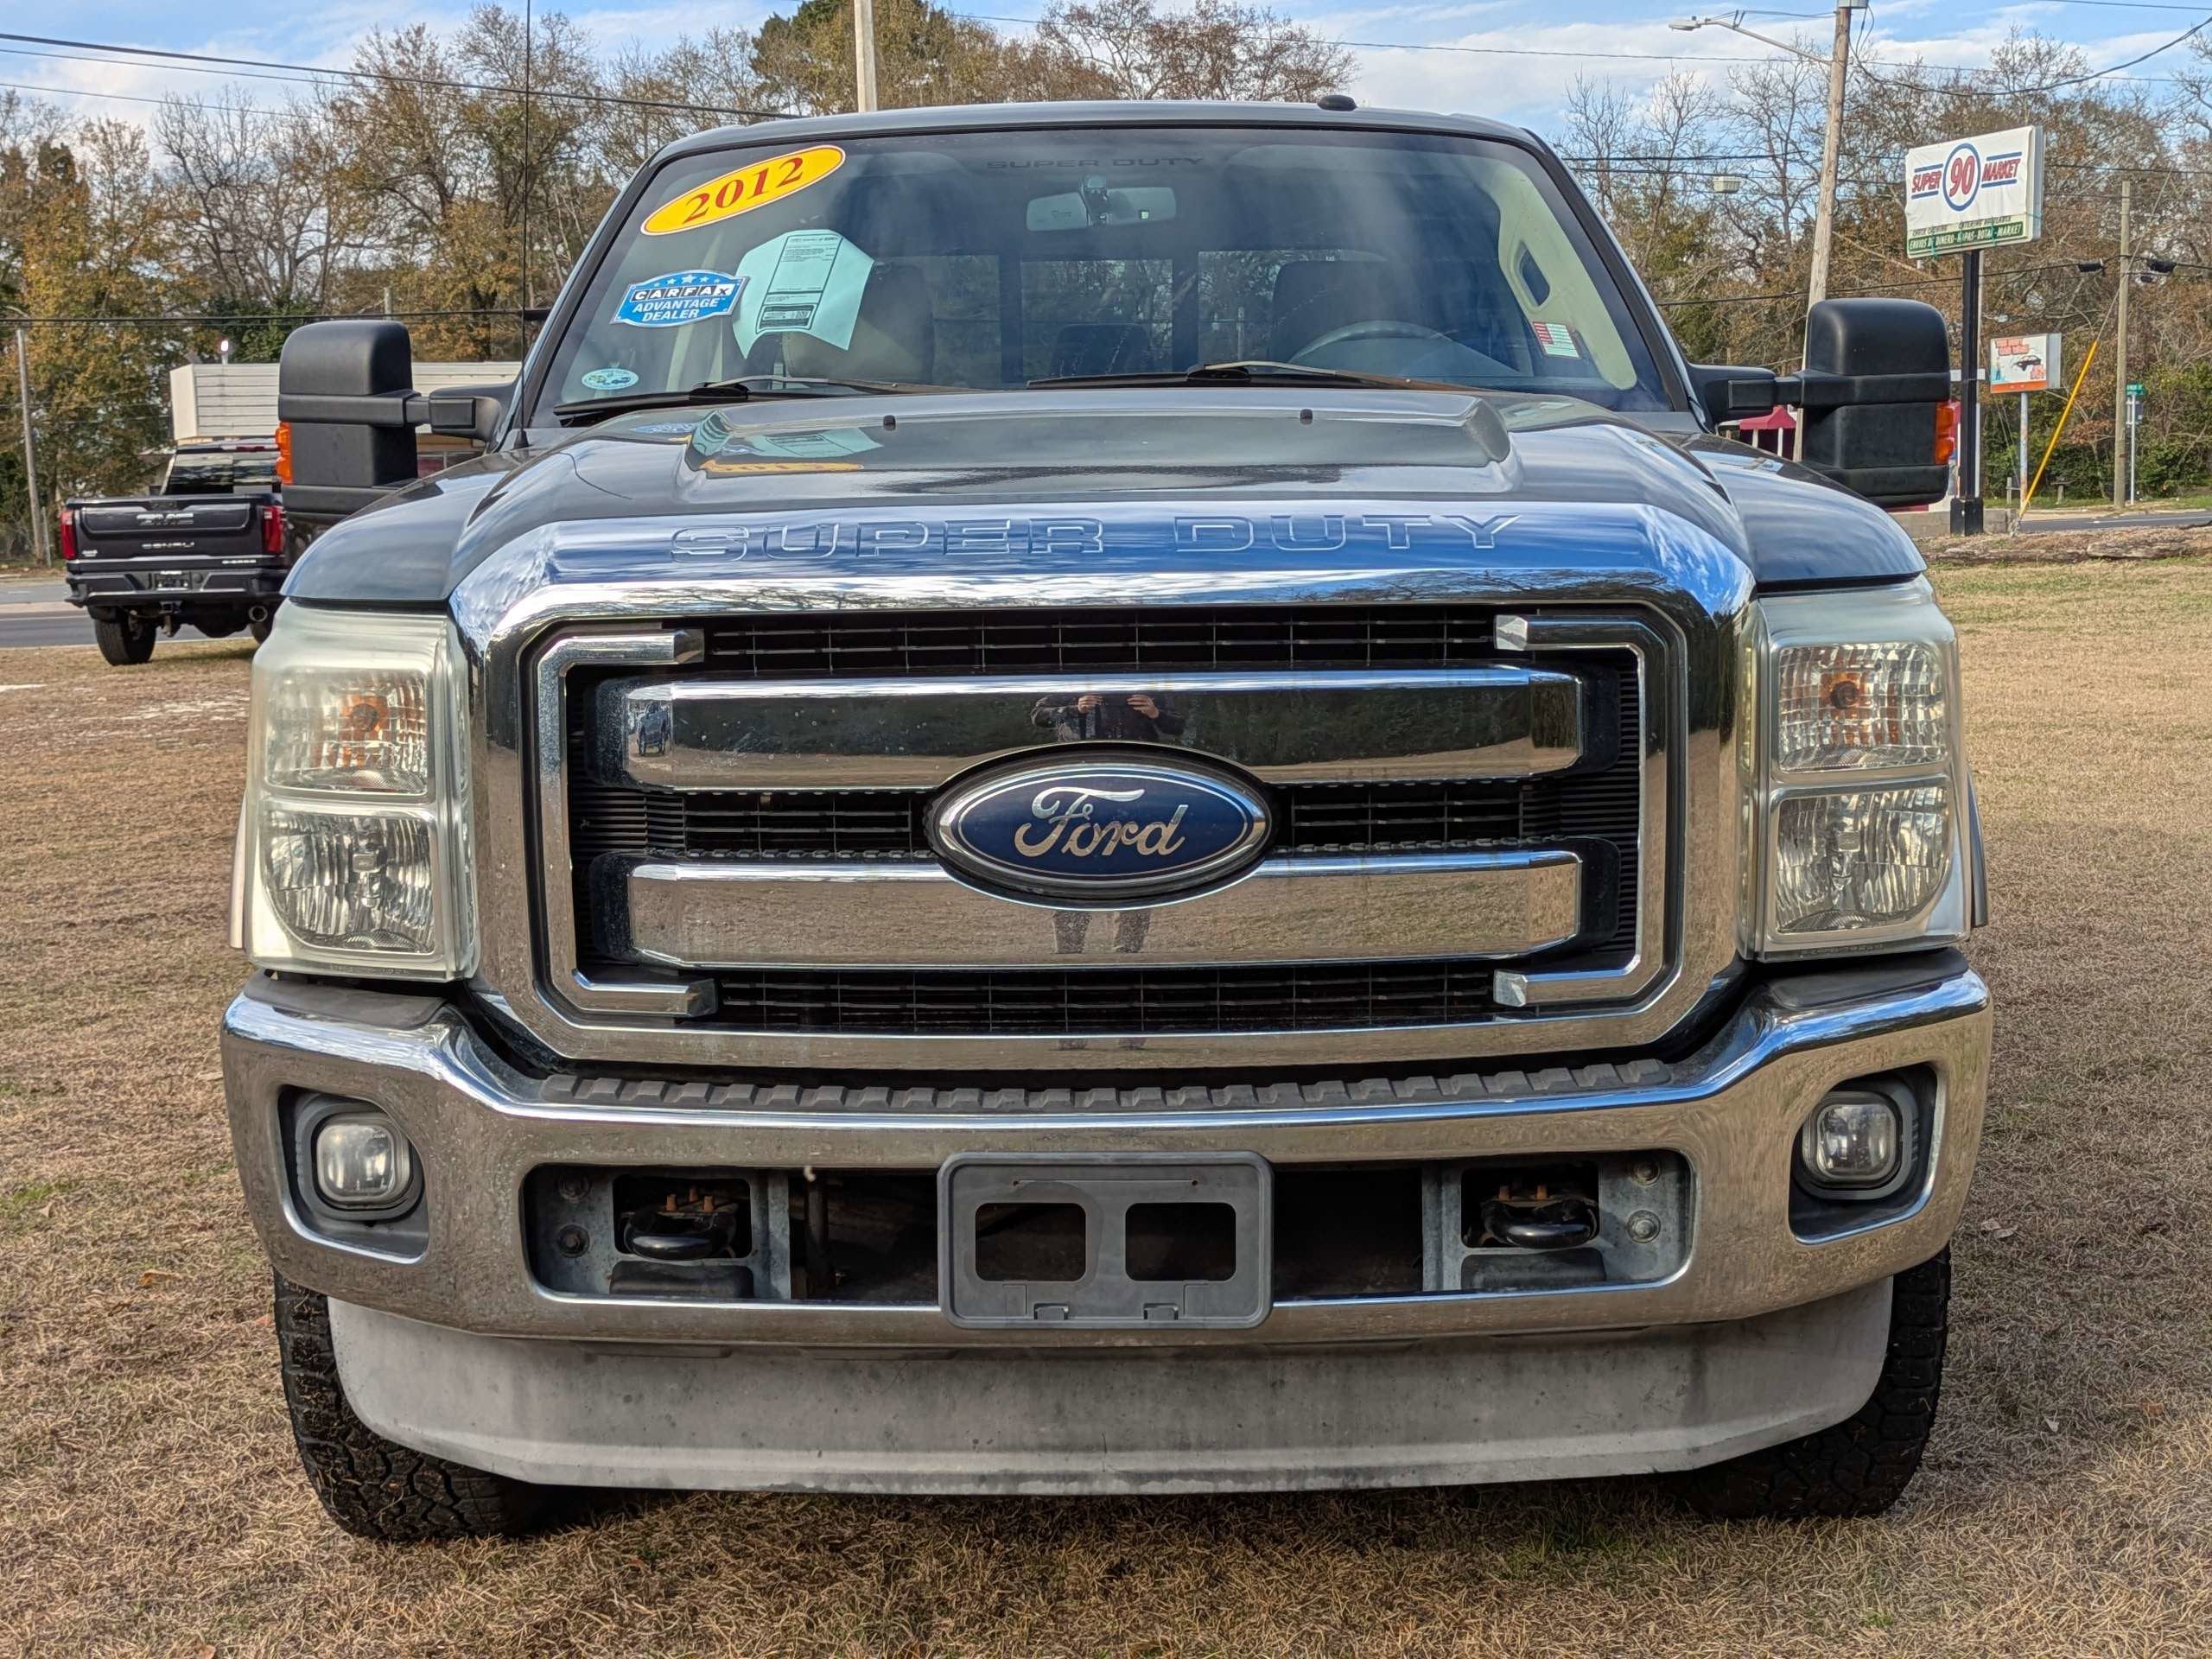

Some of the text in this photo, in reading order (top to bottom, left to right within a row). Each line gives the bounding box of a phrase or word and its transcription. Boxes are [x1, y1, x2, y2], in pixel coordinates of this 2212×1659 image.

[986, 156, 1204, 169] SUPER DUTY
[1911, 155, 2022, 198] SUPER 90 MARKET
[681, 156, 804, 225] 2012
[632, 298, 719, 313] ADVANTAGE
[633, 285, 731, 301] CARFAX
[642, 309, 700, 321] DEALER
[670, 514, 1522, 563] SUPER DUTY
[1014, 786, 1189, 857] Ford
